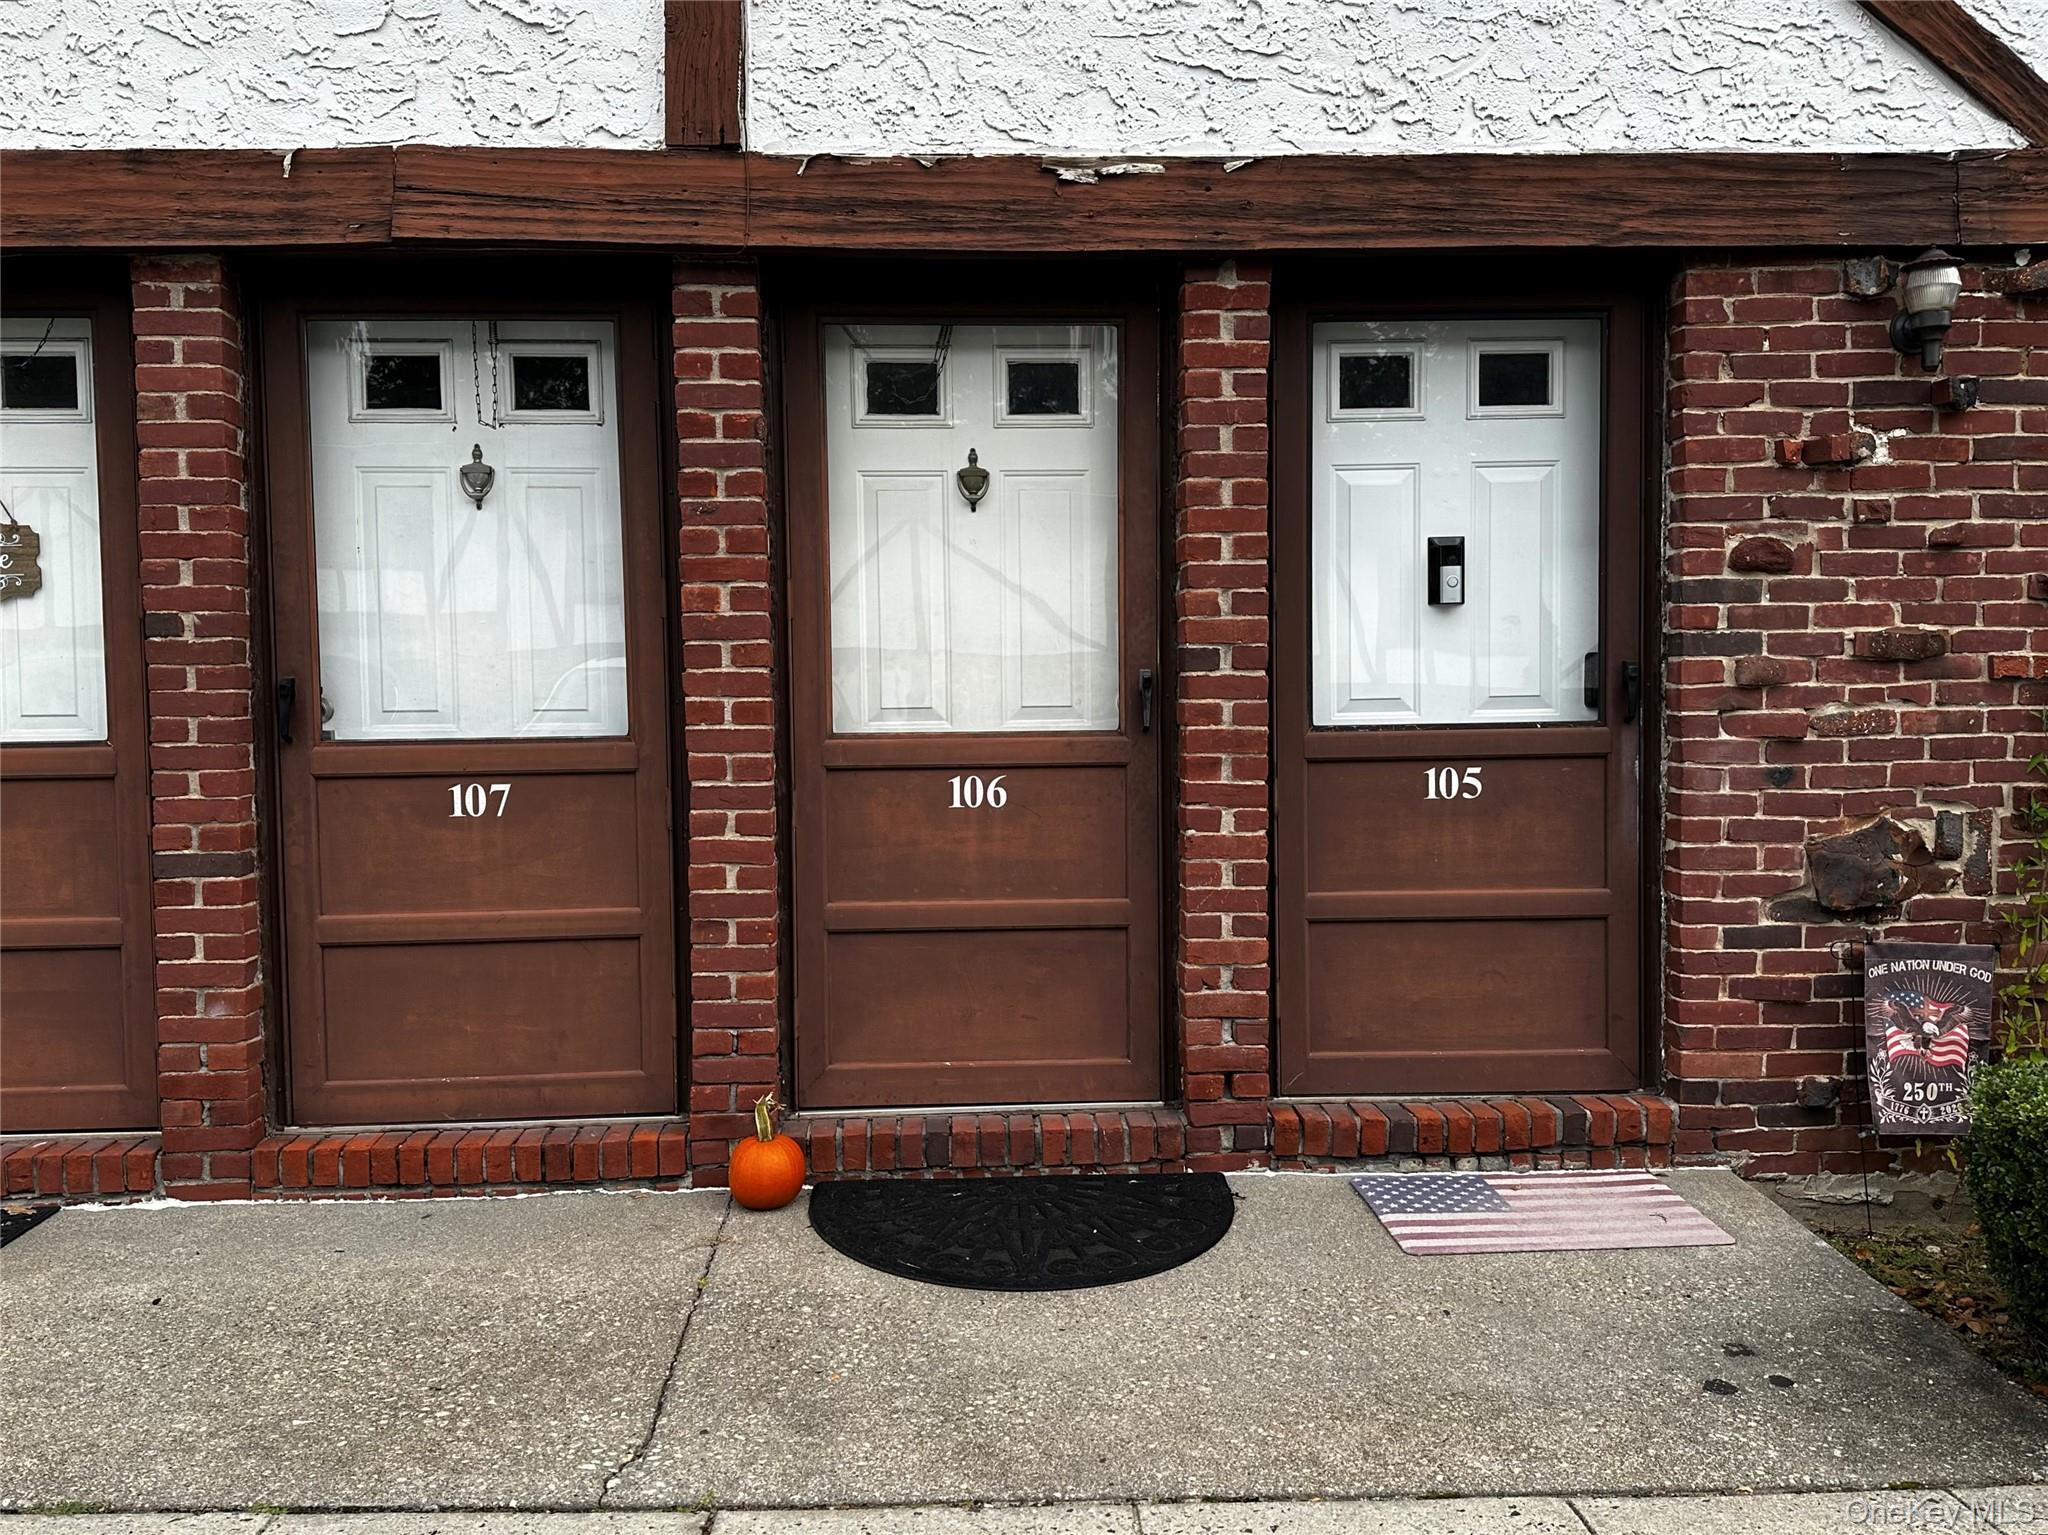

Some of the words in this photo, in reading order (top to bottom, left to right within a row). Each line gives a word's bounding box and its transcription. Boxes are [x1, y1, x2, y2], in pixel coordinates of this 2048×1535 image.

[948, 775, 1008, 809] 106
[1424, 767, 1483, 800] 105
[448, 784, 511, 818] 107
[1868, 964, 1888, 978] ONE
[1891, 960, 1930, 973] NATION
[1932, 960, 1967, 976] UNDER
[1969, 967, 1992, 983] GOD
[1902, 1082, 1953, 1101] 250TH
[1890, 1101, 1910, 1115] 1776
